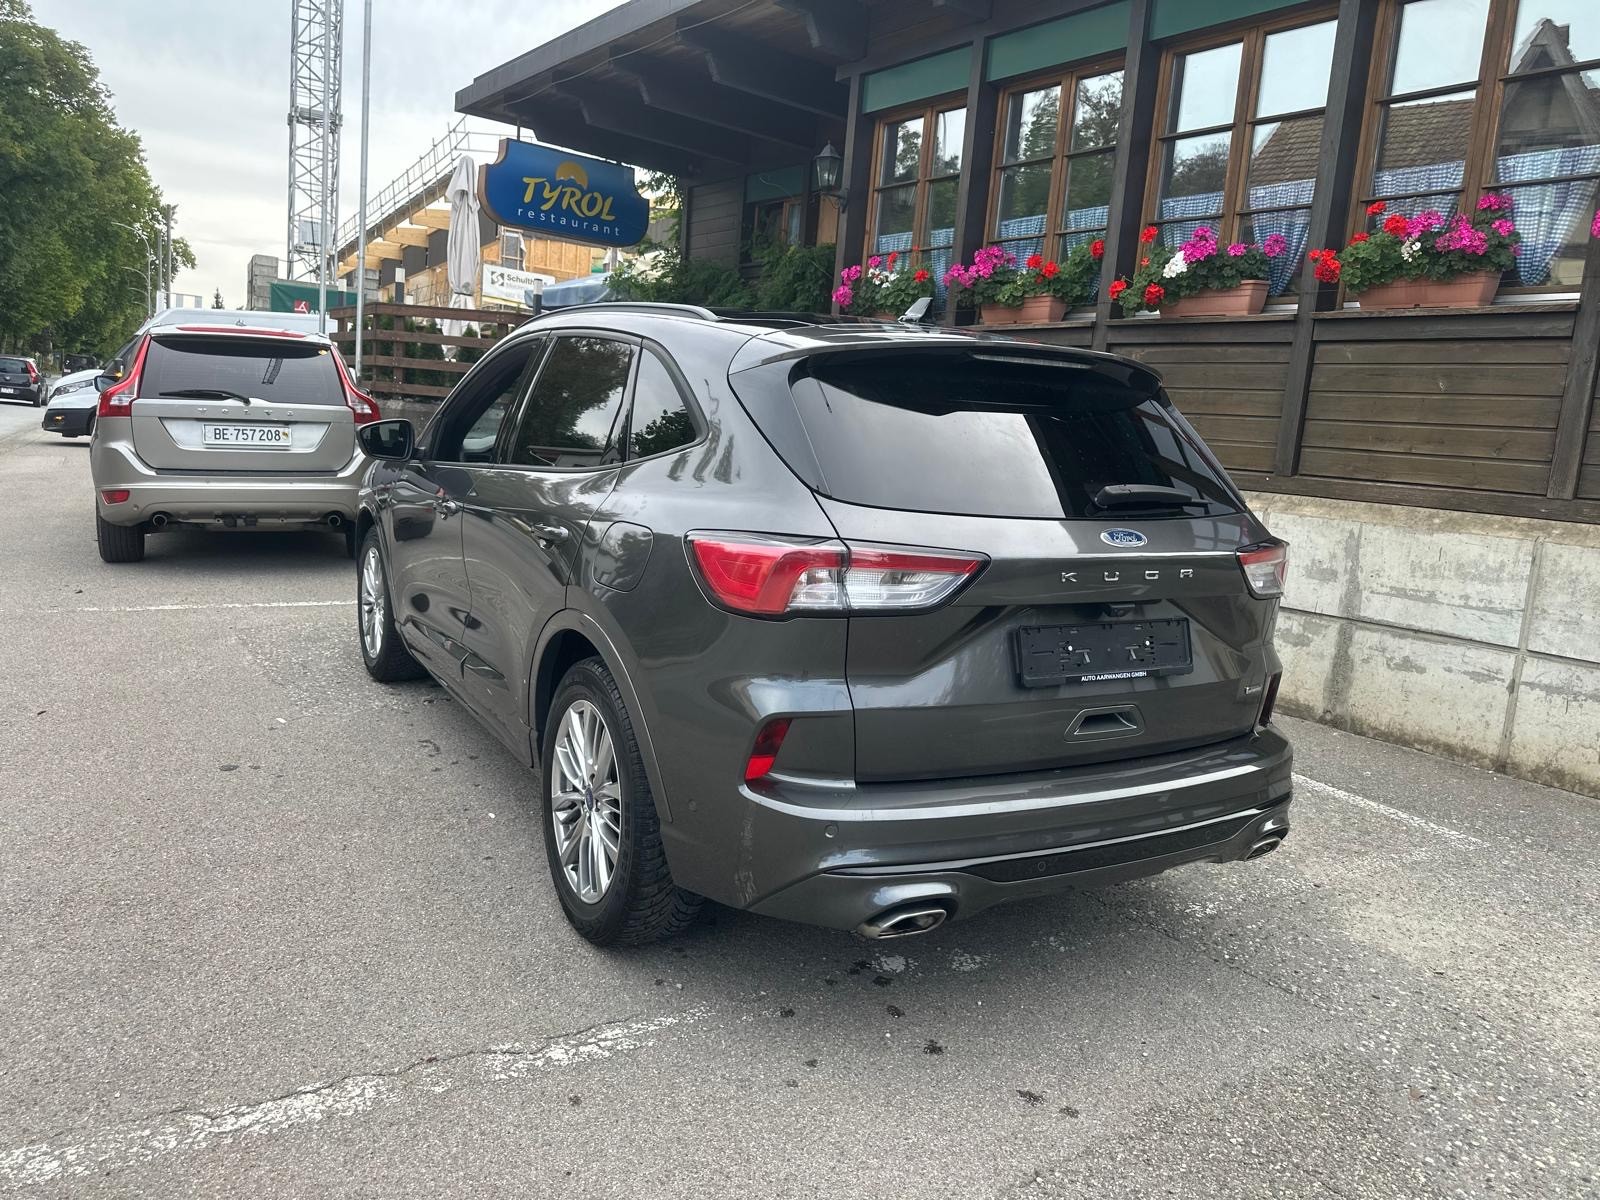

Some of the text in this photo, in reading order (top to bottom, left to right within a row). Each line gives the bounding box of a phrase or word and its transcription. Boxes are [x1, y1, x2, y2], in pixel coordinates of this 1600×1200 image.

[522, 176, 616, 221] TYROL
[517, 207, 619, 236] restaurant
[1113, 531, 1138, 543] Ford
[1061, 568, 1194, 582] KUGA
[1081, 674, 1096, 682] AUTO
